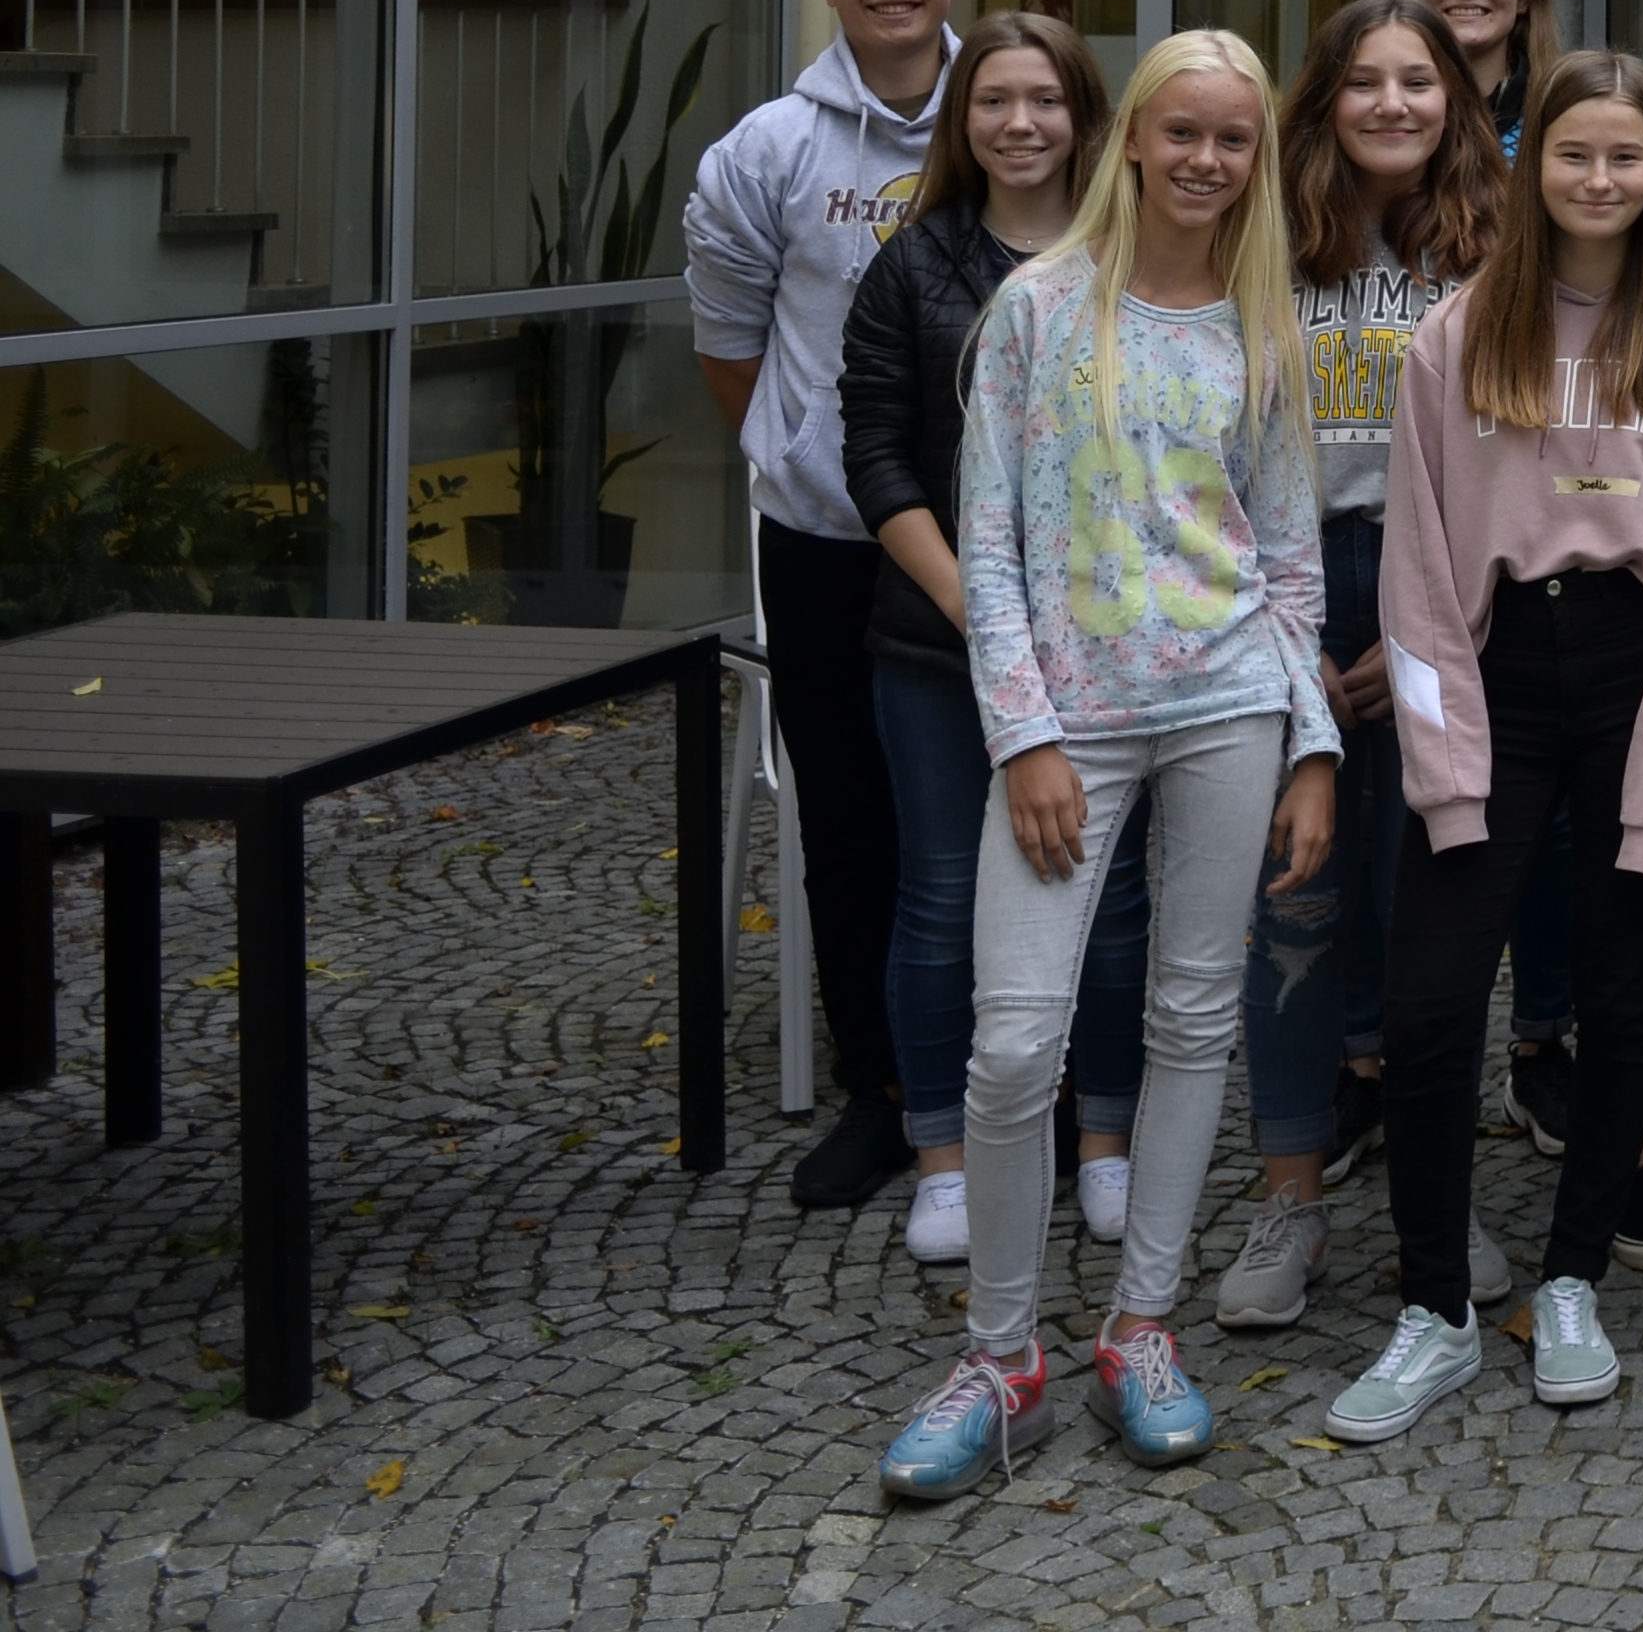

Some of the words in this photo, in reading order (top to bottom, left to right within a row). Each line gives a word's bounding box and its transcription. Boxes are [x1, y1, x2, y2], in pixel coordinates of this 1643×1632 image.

[1313, 328, 1412, 420] SKET
[1313, 430, 1393, 443] GIAN
[1576, 479, 1611, 491] Joelle
[1069, 436, 1237, 637] 63
